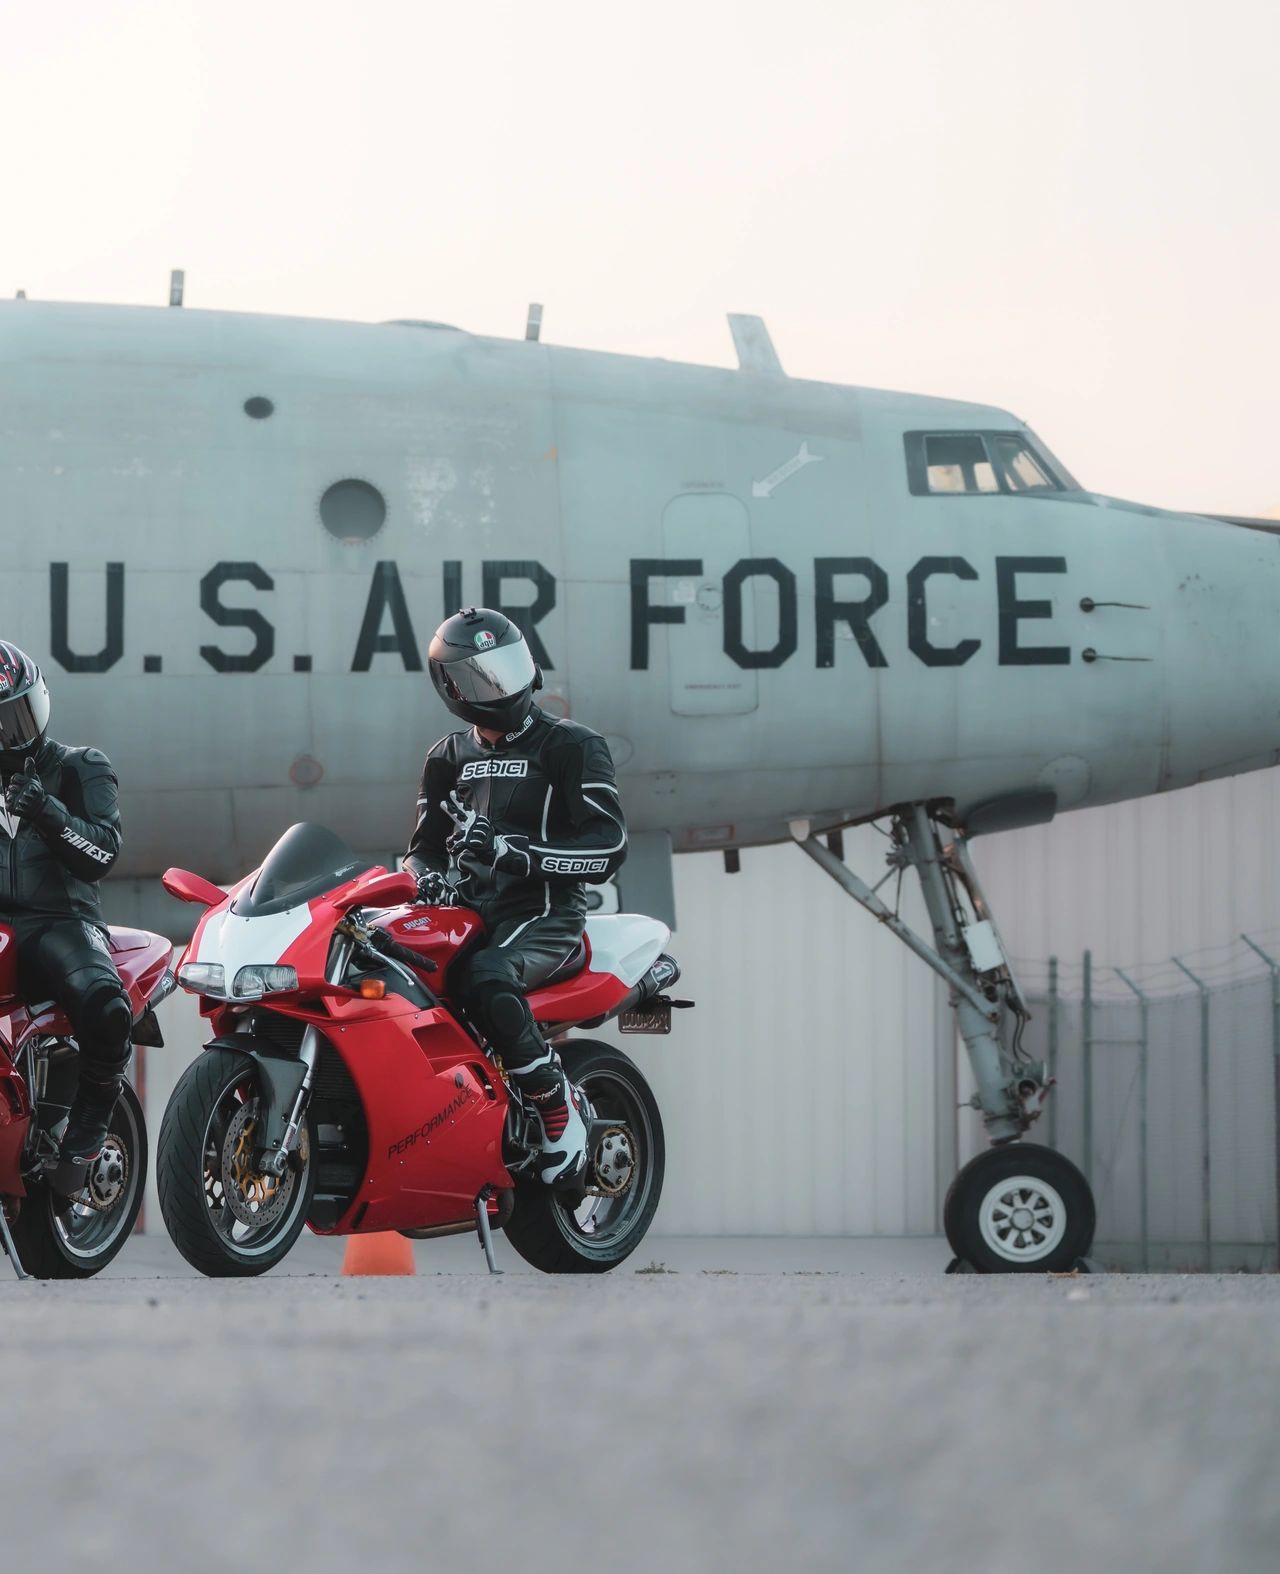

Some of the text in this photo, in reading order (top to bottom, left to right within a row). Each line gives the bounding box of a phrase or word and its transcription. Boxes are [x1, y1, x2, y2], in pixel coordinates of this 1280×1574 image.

[630, 556, 1071, 671] FORCE
[461, 760, 528, 781] SEDICI
[541, 857, 609, 874] SEDICI
[403, 916, 432, 930] DUCATI
[387, 1083, 472, 1160] PERFORMANCE
